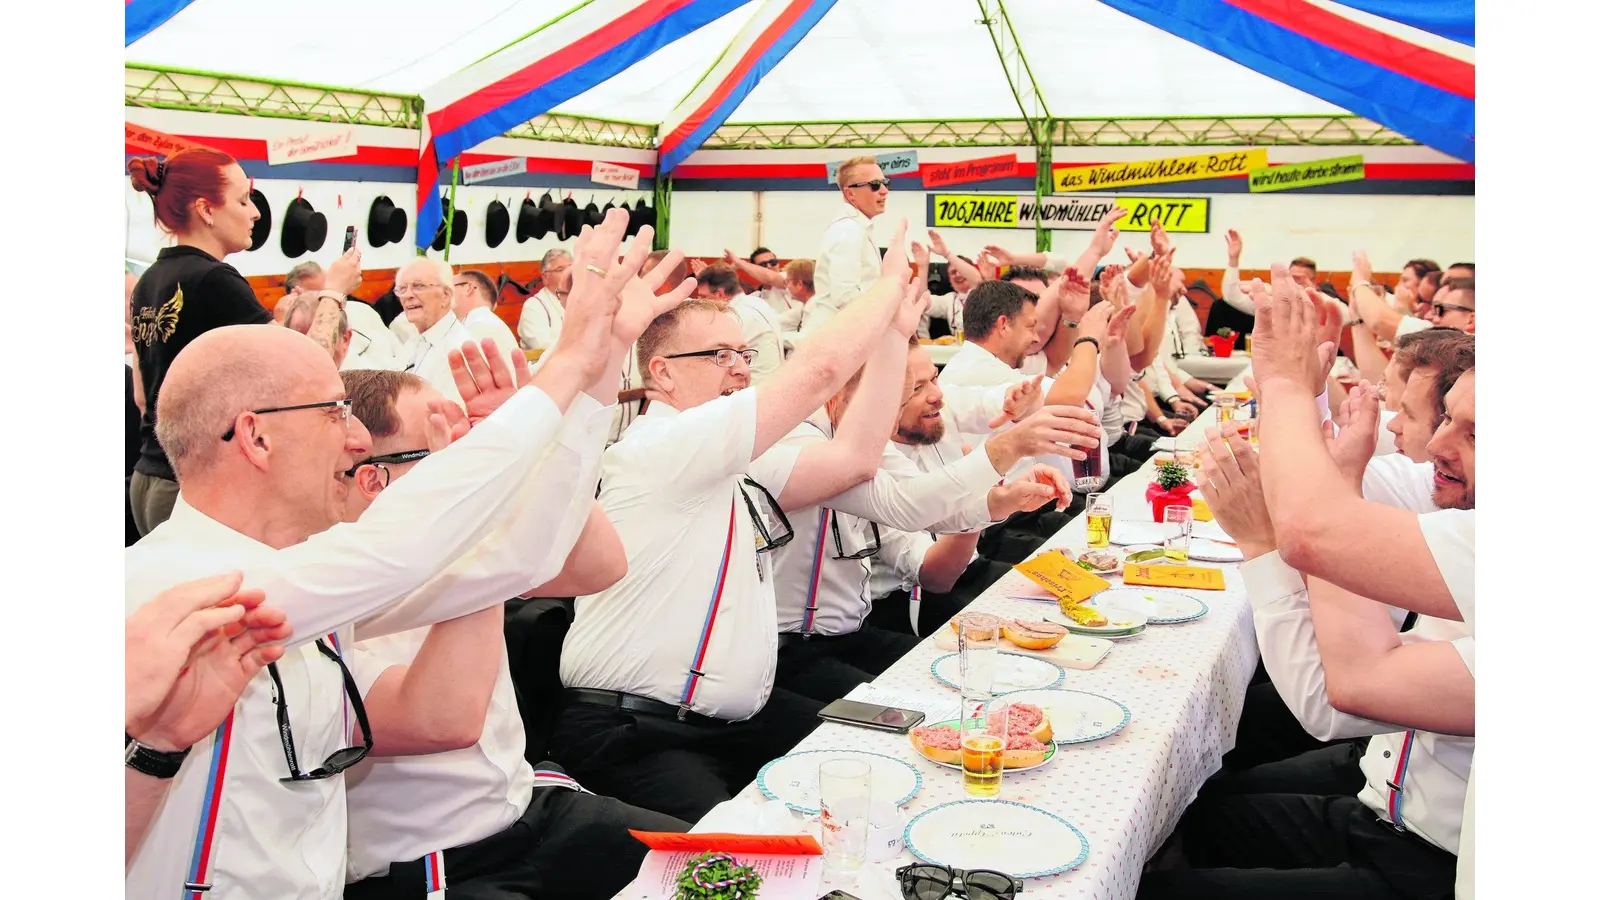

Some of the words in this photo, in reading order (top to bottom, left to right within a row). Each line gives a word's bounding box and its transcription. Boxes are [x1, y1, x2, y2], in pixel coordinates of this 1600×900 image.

[1061, 174, 1083, 187] das
[1252, 172, 1275, 187] wird
[1130, 203, 1192, 226] ROTT
